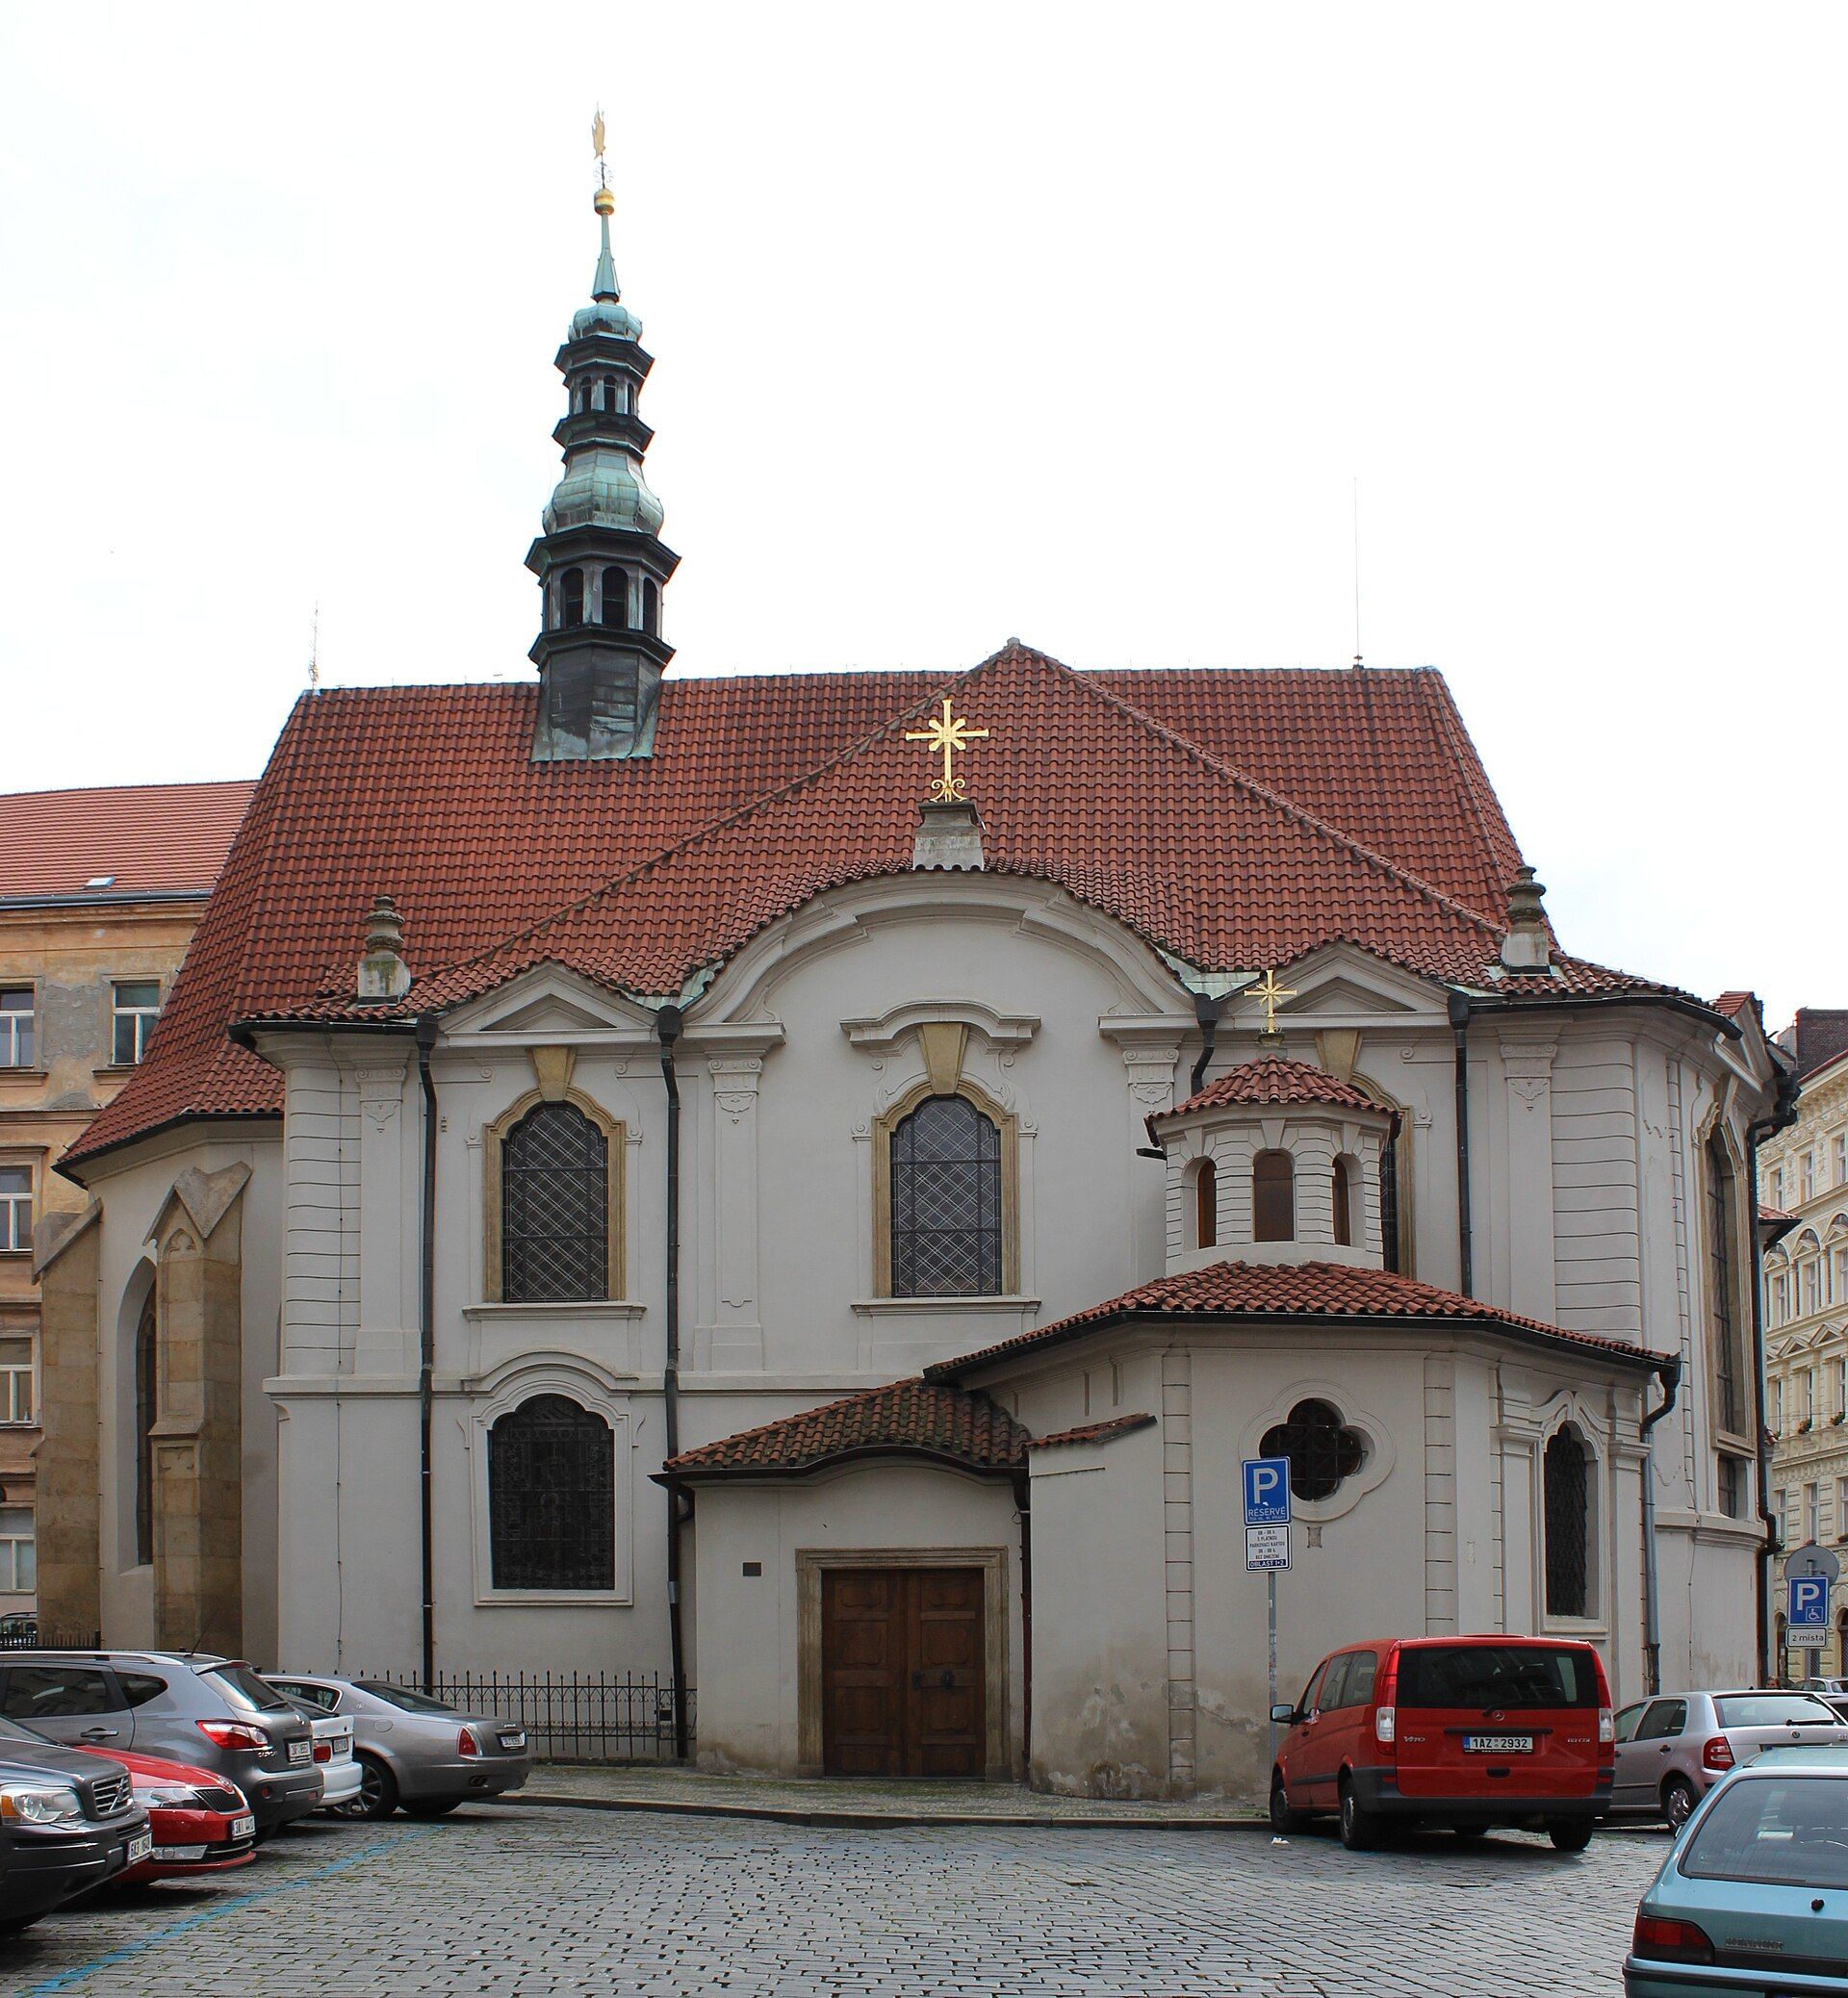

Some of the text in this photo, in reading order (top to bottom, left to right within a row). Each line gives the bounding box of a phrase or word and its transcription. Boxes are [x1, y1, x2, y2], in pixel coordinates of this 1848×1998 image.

[1253, 1467, 1278, 1504] P
[1797, 1583, 1820, 1611] P
[1799, 1633, 1824, 1642] místa
[1473, 1738, 1493, 1748] 1AZ
[1501, 1738, 1527, 1748] 2932
